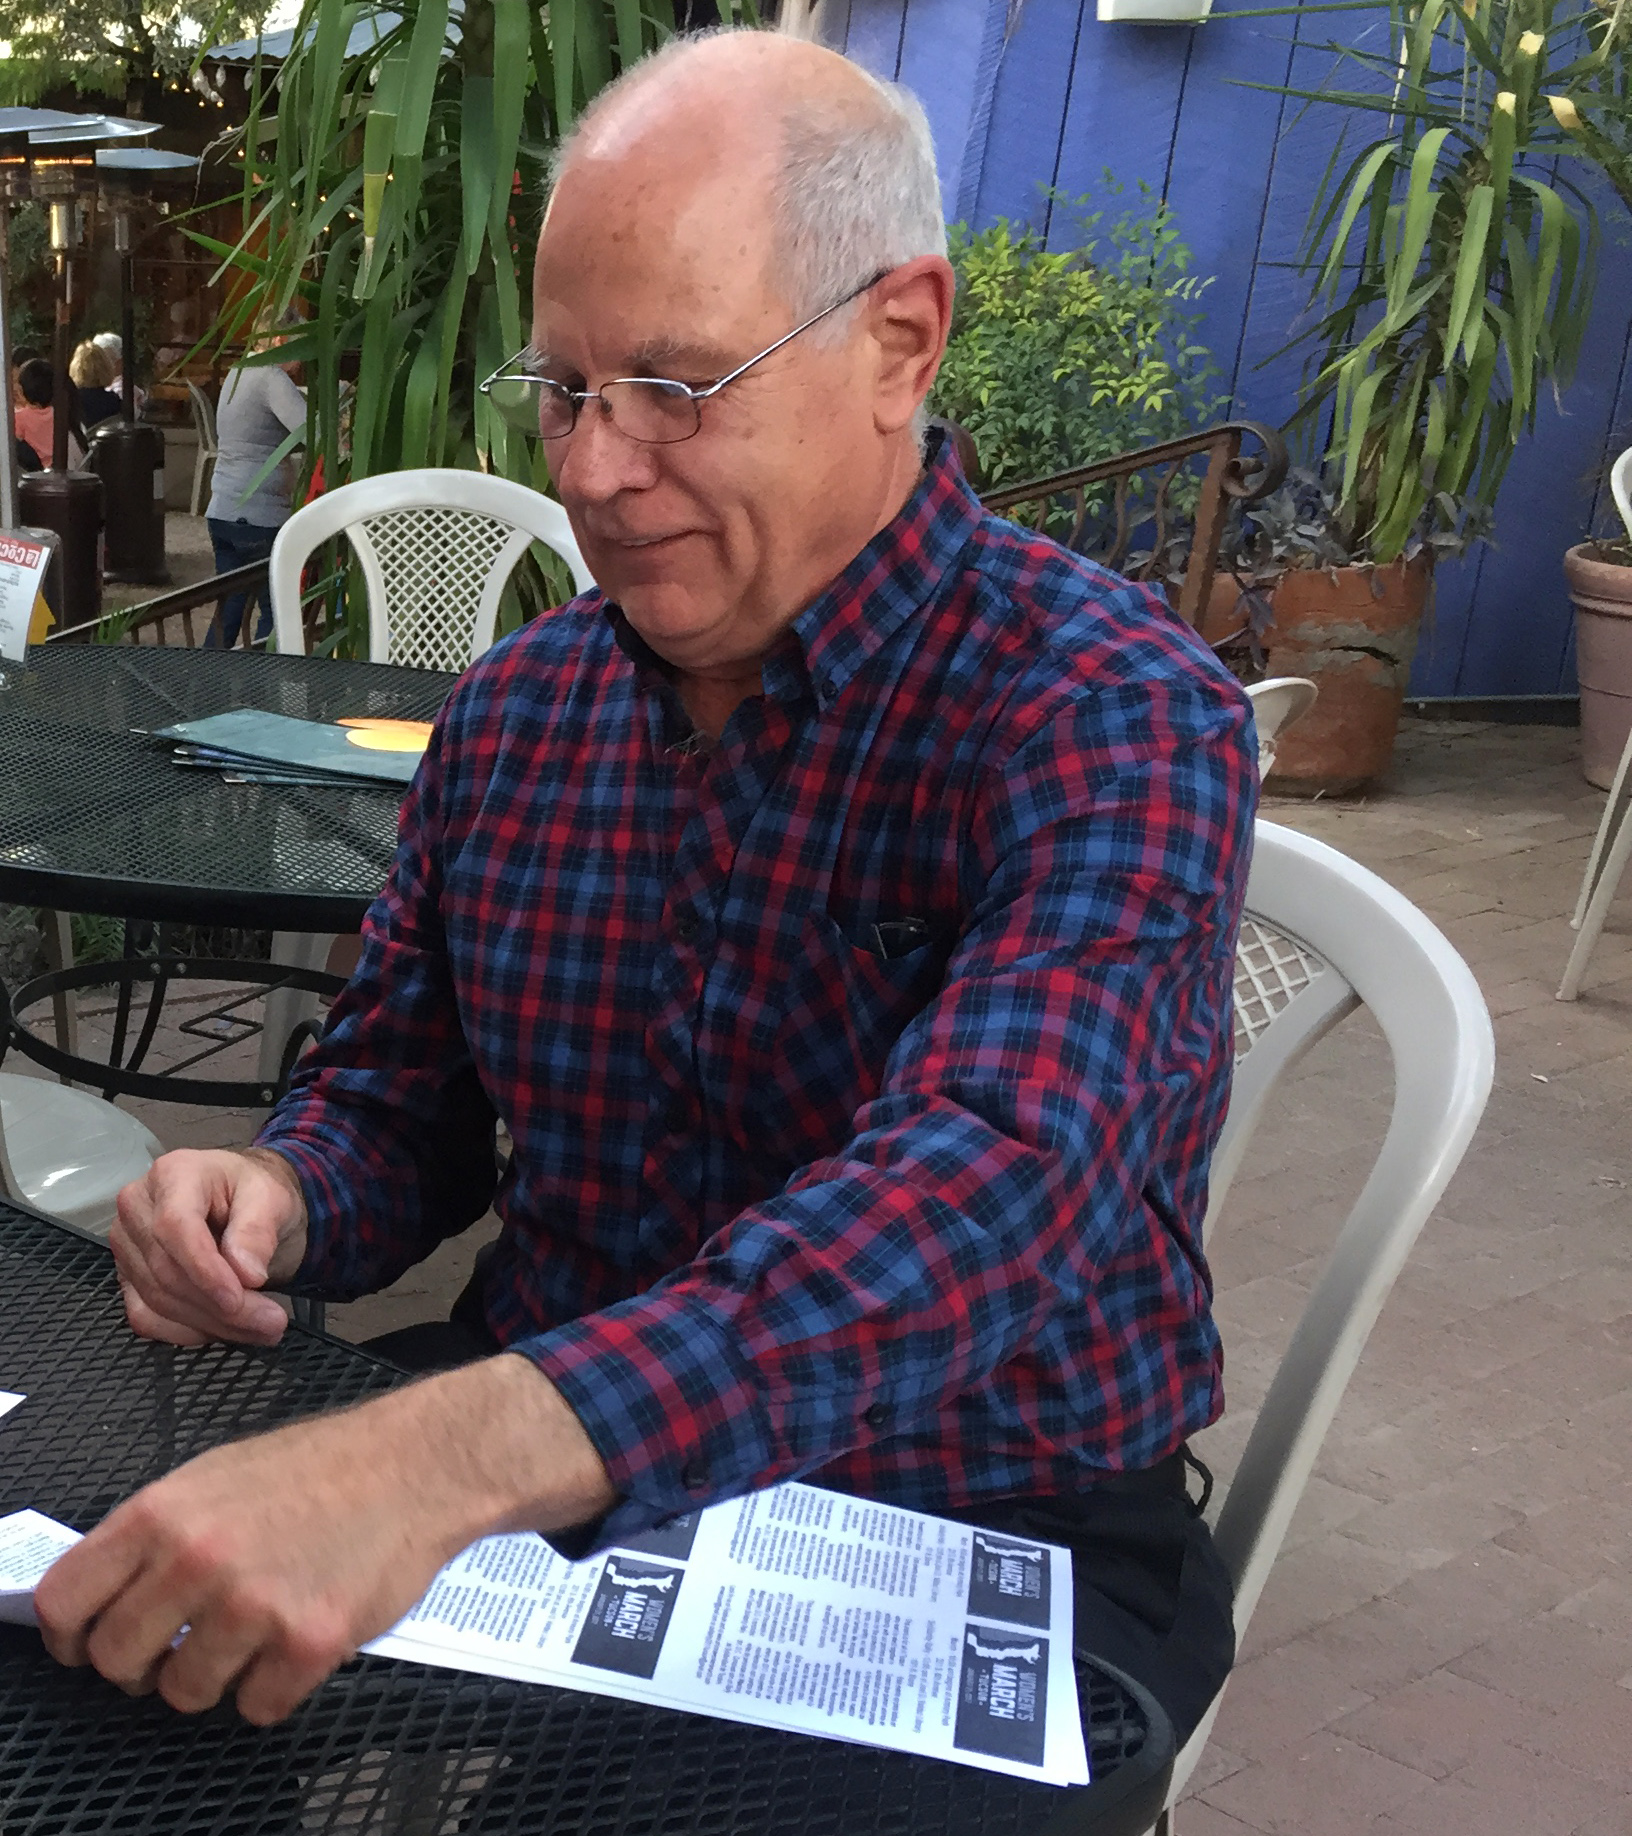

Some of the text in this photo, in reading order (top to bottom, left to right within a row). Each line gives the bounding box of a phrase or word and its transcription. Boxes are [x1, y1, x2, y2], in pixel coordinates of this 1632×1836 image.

[25, 549, 40, 568] La
[999, 1559, 1022, 1596] MARCH
[611, 1591, 647, 1639] MARCH
[638, 1598, 664, 1641] WOMEN'S
[978, 1673, 988, 1700] TUCSON
[990, 1665, 1016, 1720] MARCH
[1018, 1673, 1035, 1721] WOMEN'S
